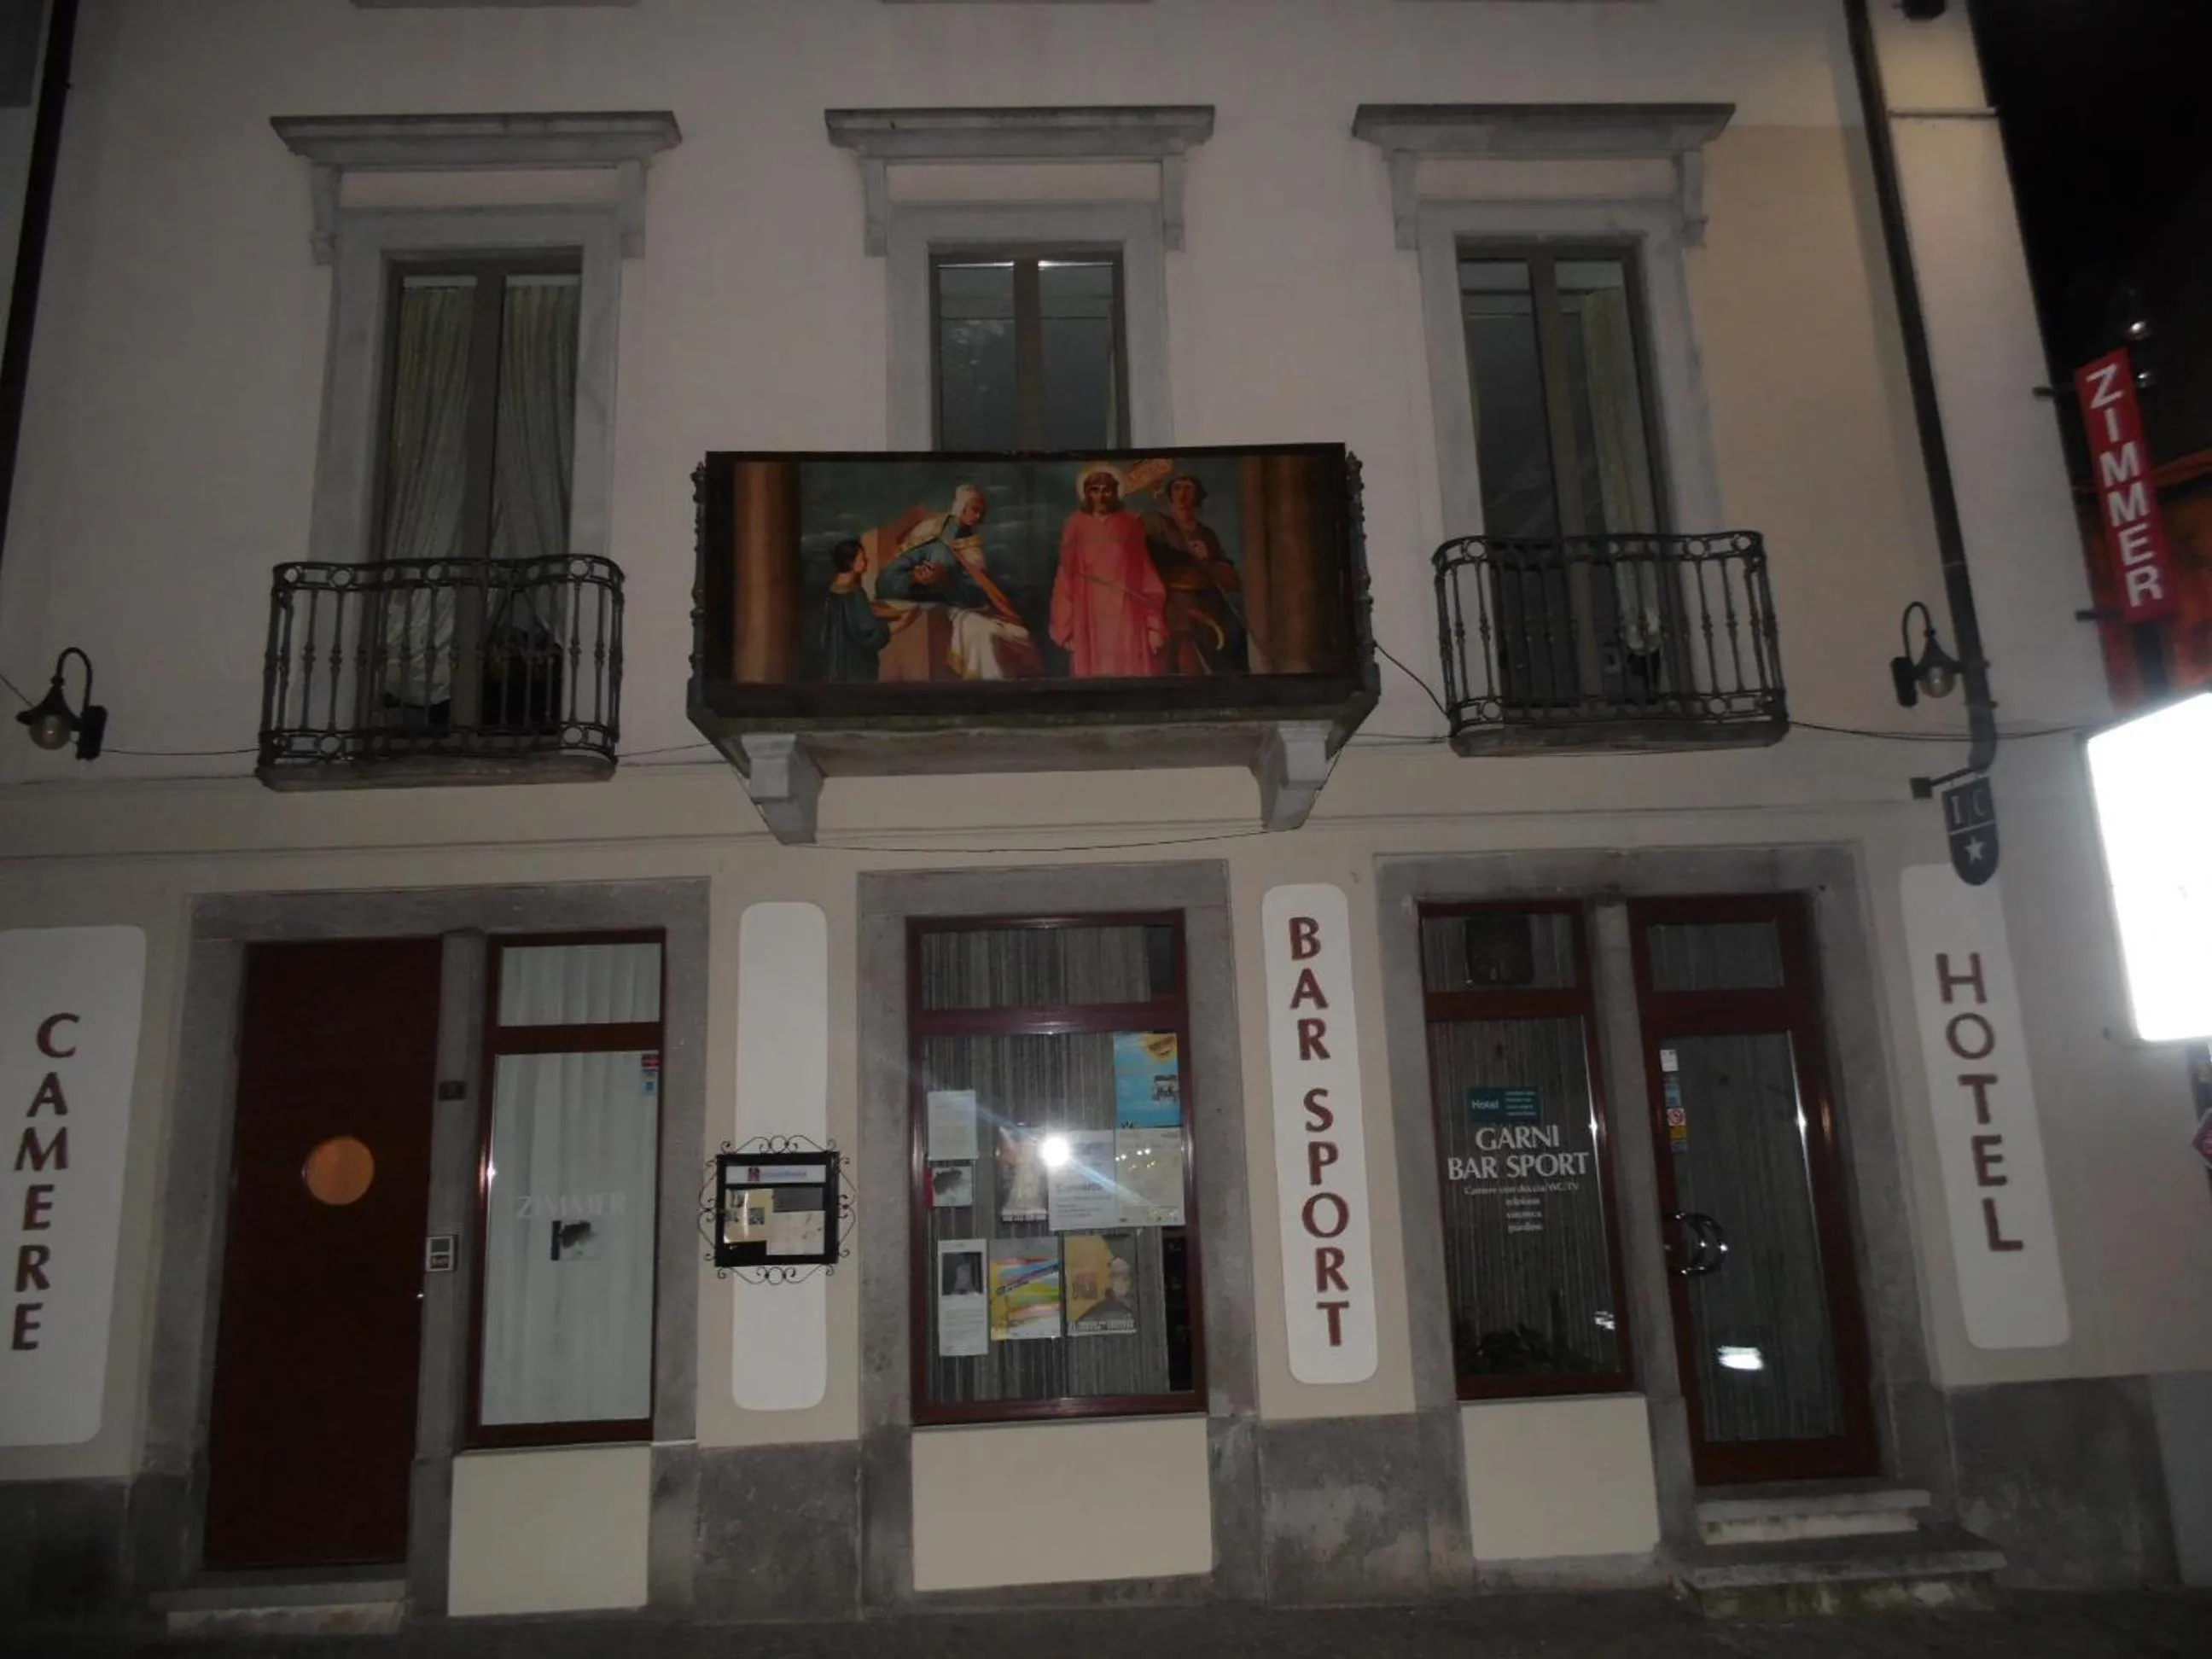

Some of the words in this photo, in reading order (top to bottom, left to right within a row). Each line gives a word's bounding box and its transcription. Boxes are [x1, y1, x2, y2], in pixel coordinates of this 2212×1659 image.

[2086, 363, 2165, 608] ZIMMER
[1289, 917, 1330, 1061] BAR
[11, 1012, 80, 1350] CAMERE
[1447, 1156, 1499, 1180] BAR
[1506, 1151, 1590, 1179] SPORT
[1475, 1124, 1560, 1151] GARNI
[1935, 952, 2024, 1252] HOTEL
[515, 1191, 627, 1220] ZIMMER
[1301, 1087, 1351, 1346] SPORT
